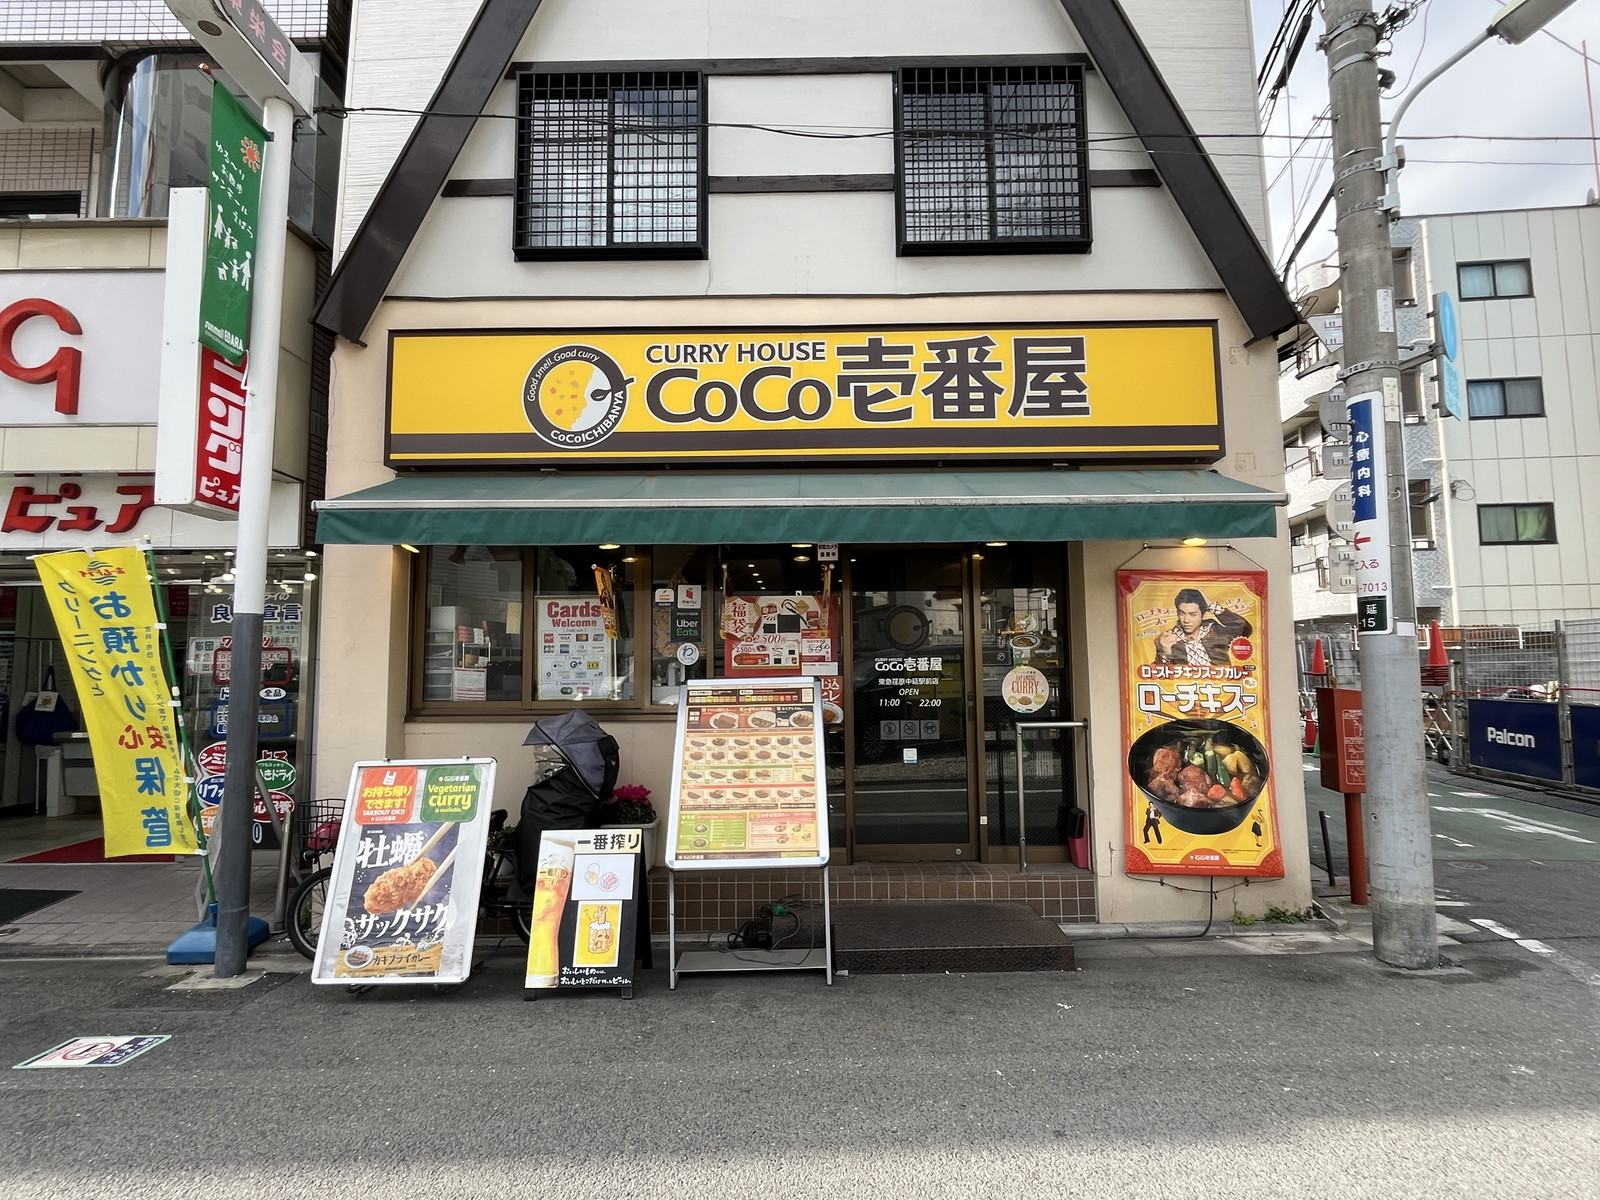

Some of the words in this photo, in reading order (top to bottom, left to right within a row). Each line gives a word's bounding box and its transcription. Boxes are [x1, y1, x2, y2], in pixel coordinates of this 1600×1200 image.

[646, 343, 730, 364] CURRY
[737, 341, 826, 362] HOUSE
[527, 378, 538, 402] Good
[553, 349, 577, 361] Good
[577, 349, 600, 362] curry
[646, 335, 1092, 425] CoCo壱番屋
[1356, 431, 1372, 497] 心療内科
[1, 482, 155, 533] ピュア
[547, 601, 601, 617] Cards
[552, 618, 597, 629] Welcome
[676, 619, 698, 628] Uber
[731, 602, 747, 633] 福袋
[676, 628, 699, 637] Eats
[1141, 666, 1249, 679] ローストチキンスープカレー
[264, 689, 282, 698] 全品
[898, 688, 920, 696] OPEN
[1012, 681, 1039, 694] CURRY
[879, 699, 900, 707] 11:00
[918, 699, 942, 707] 22:00
[1138, 684, 1257, 714] ローチキスー
[1487, 727, 1536, 748] Palcon
[362, 785, 413, 798] お持ち帰り
[428, 783, 477, 794] Vegetarian
[365, 798, 407, 809] できます!
[428, 794, 472, 810] curry
[577, 833, 640, 850] 一番搾り
[372, 954, 431, 966] カキフライカレー
